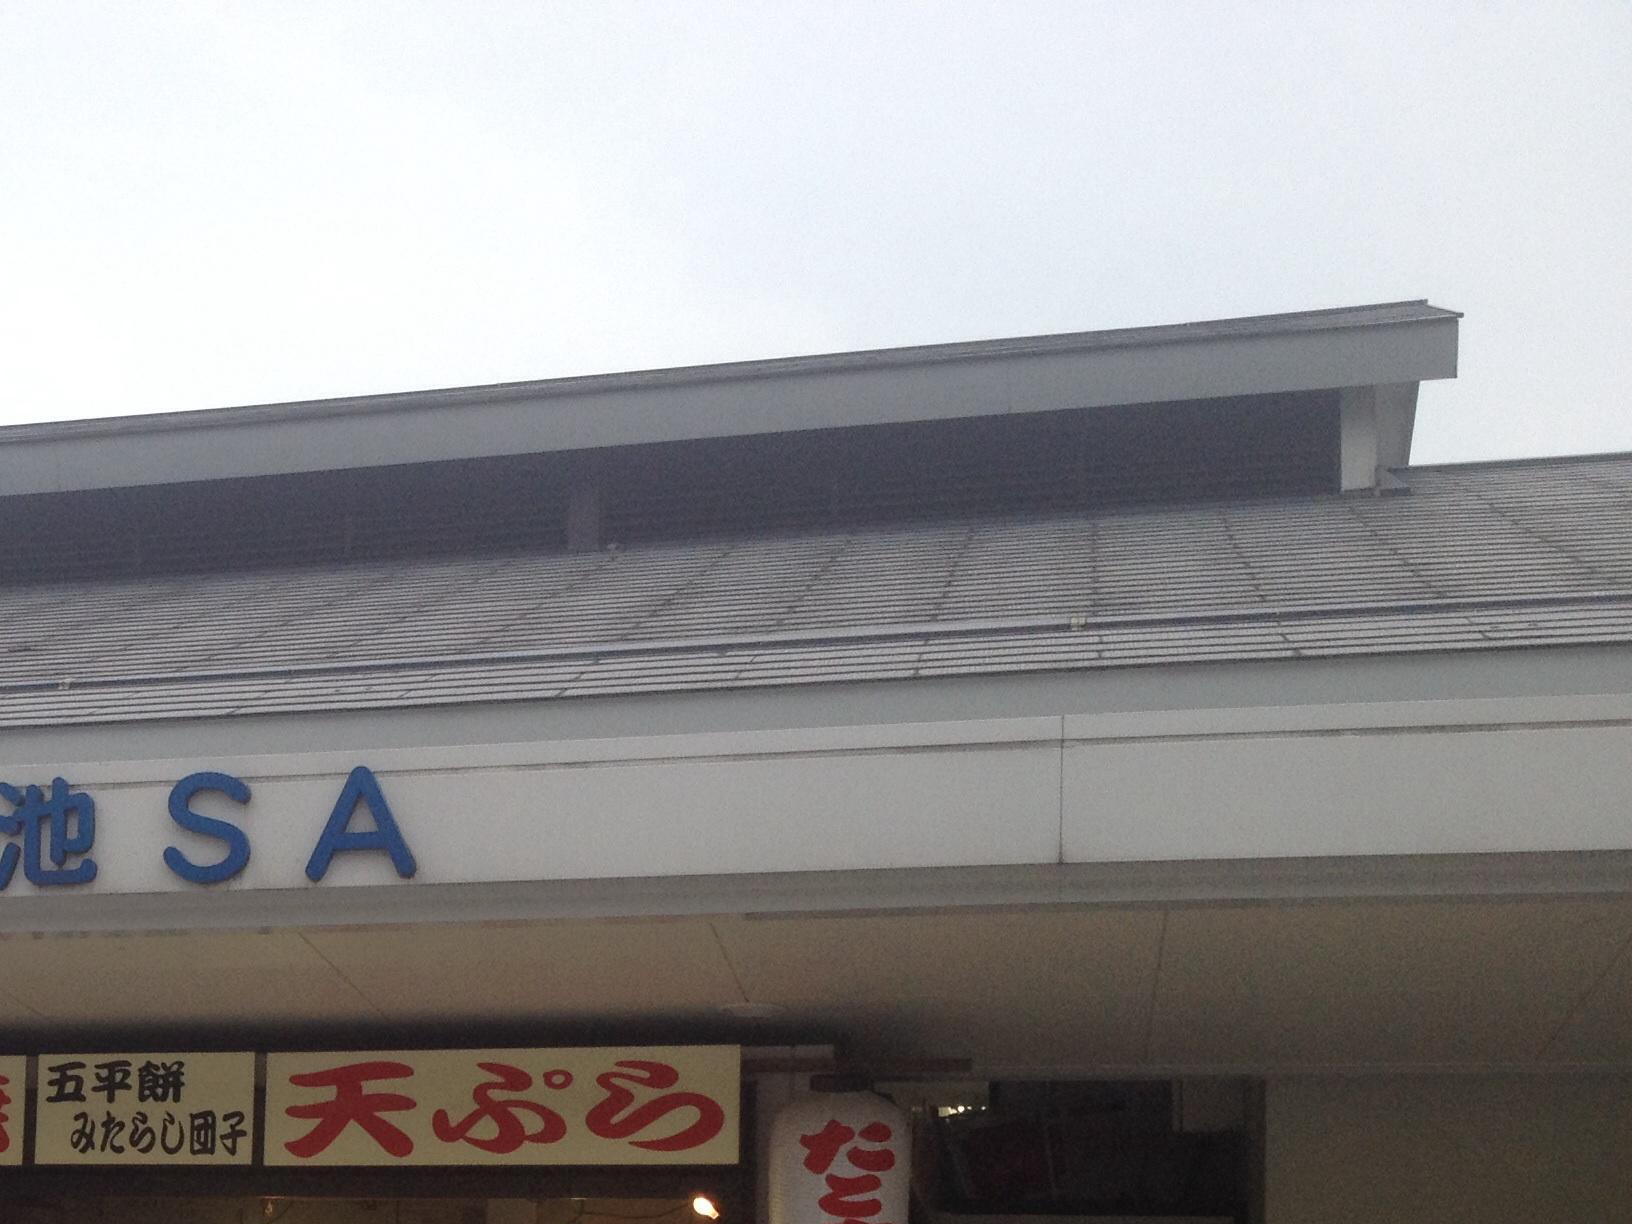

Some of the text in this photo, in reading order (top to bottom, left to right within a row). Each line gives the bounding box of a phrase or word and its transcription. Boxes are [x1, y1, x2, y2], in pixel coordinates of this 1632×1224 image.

[46, 1060, 185, 1105] 五平餅
[283, 1058, 725, 1159] 天ぷら
[70, 1109, 249, 1156] みたらし団子
